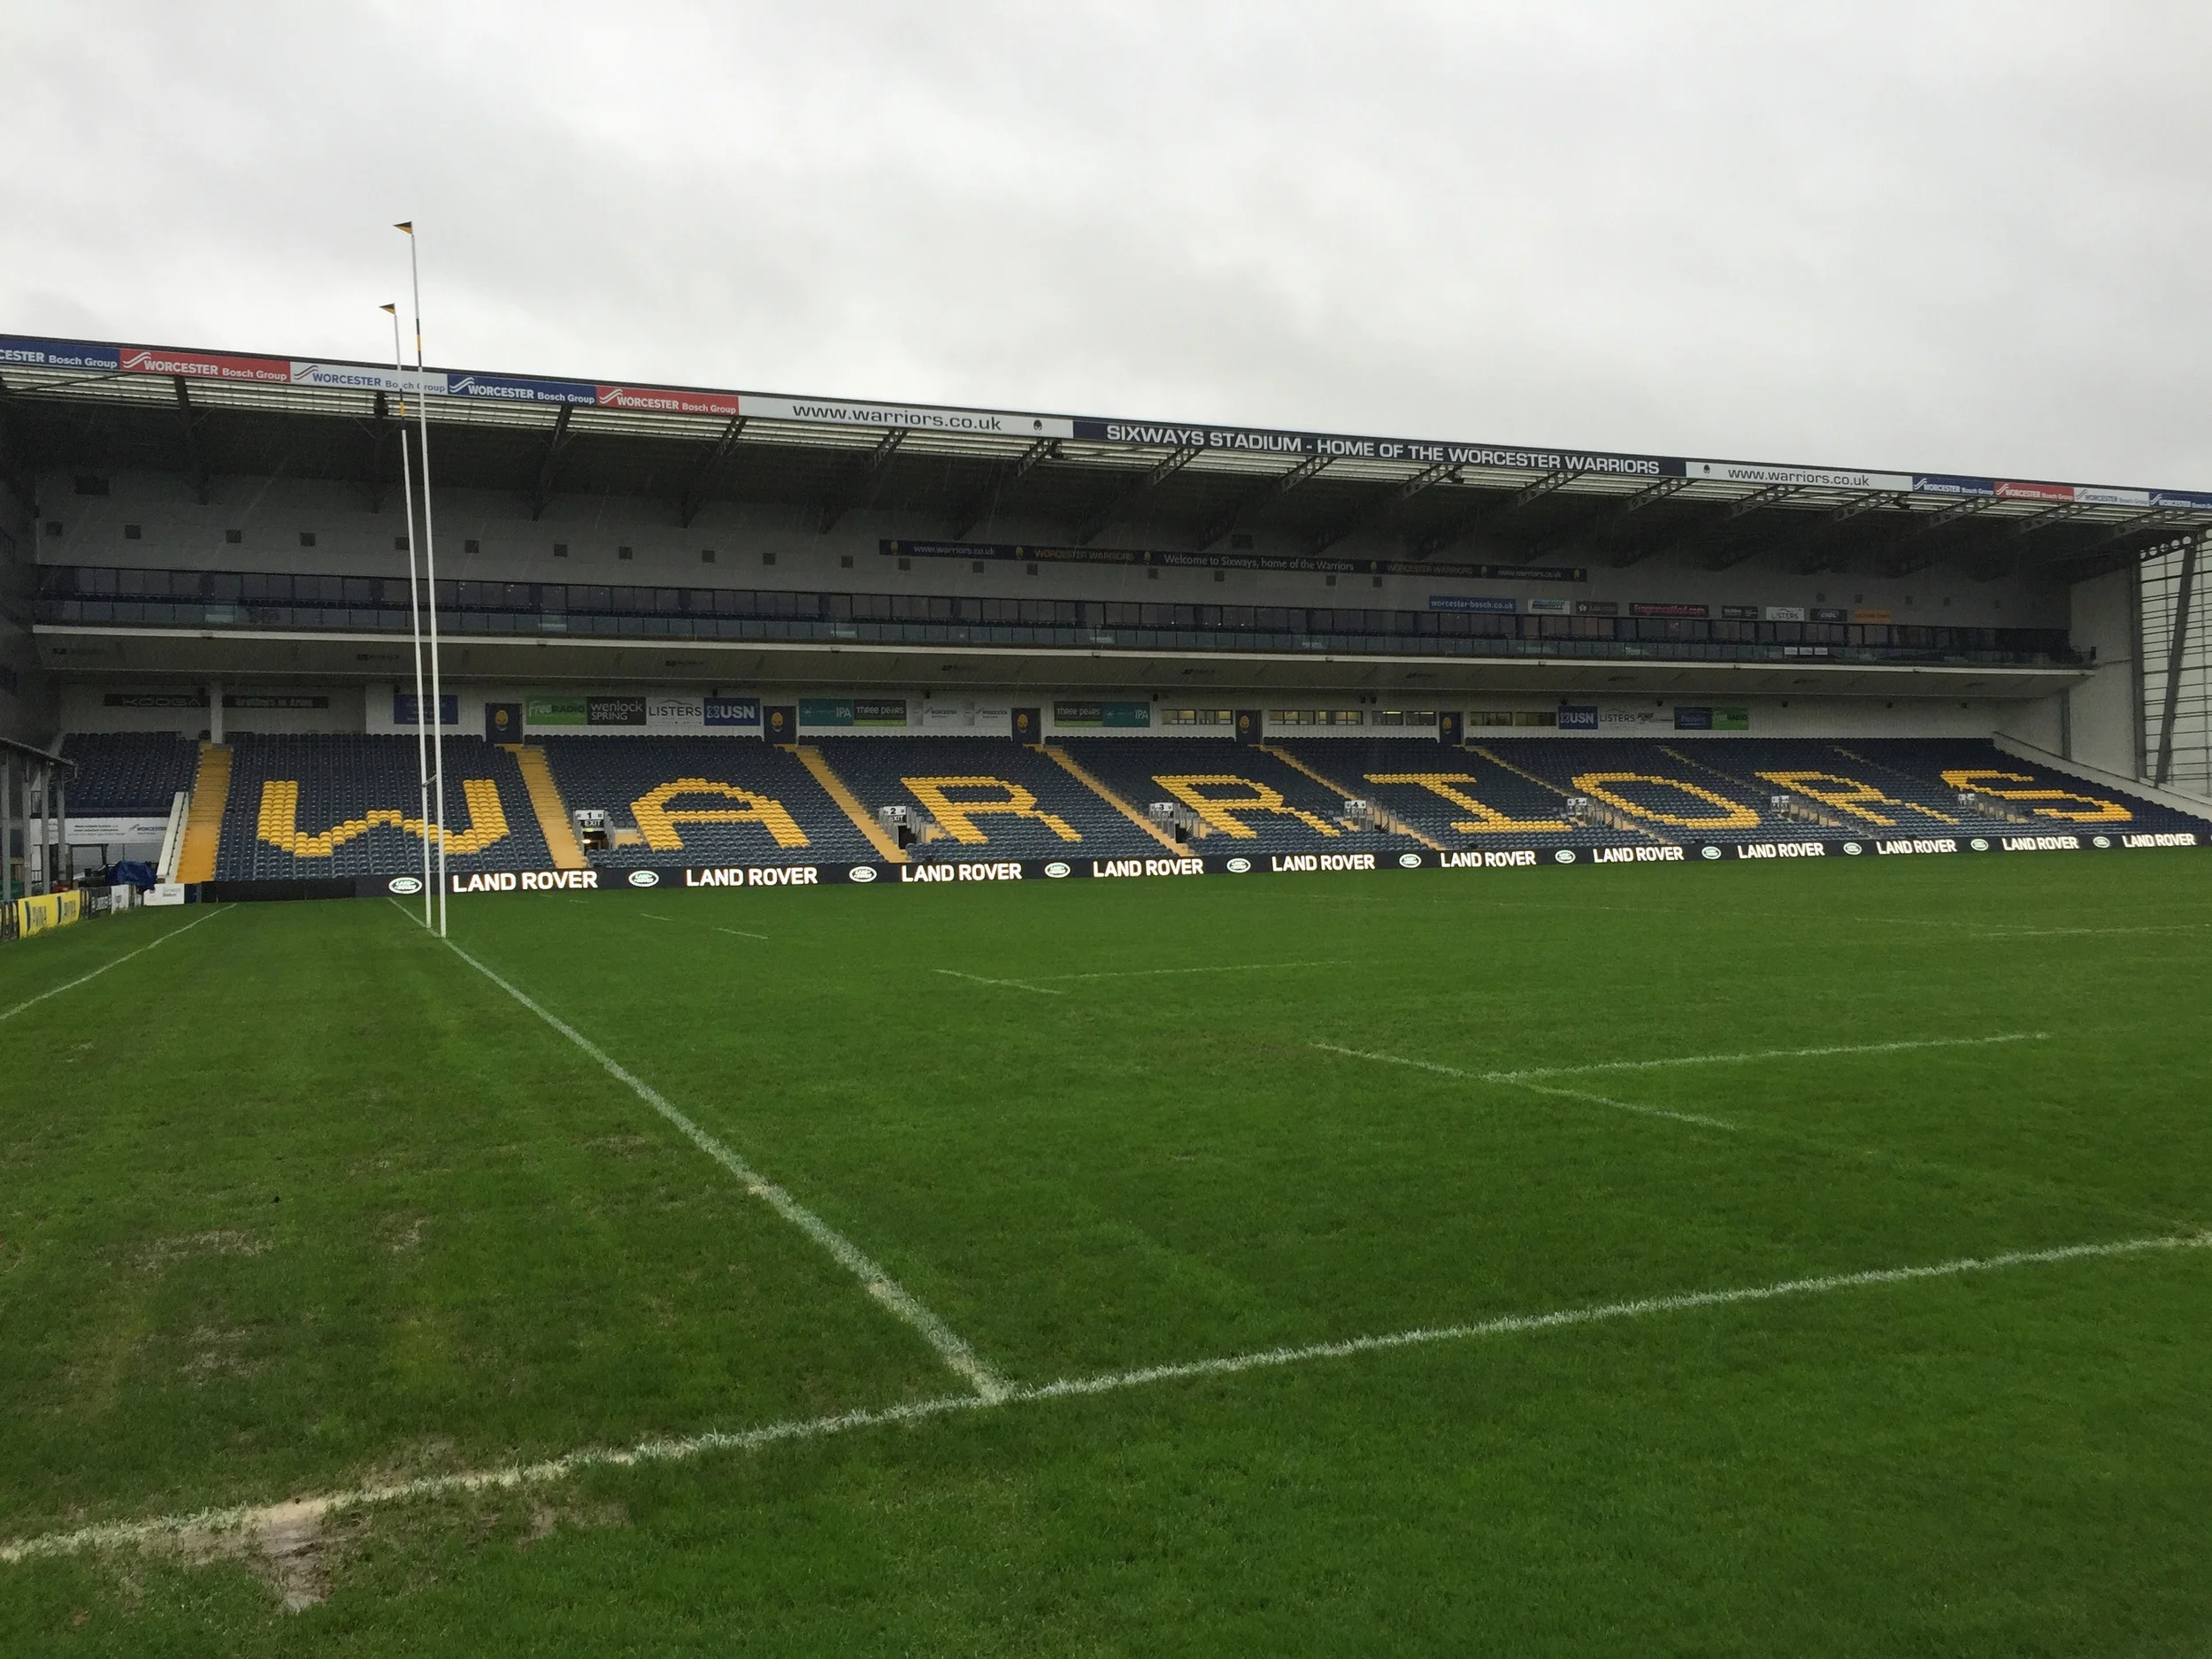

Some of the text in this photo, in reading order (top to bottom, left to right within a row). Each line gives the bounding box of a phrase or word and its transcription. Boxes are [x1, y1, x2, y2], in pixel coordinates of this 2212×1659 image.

[49, 355, 82, 366] Bosch
[84, 358, 118, 370] Group
[144, 360, 288, 381] WORCESTER Bosch Group
[312, 373, 381, 387] WORCESTER
[385, 380, 413, 390] Boch
[468, 384, 595, 405] WORCESTER Bosch Group
[618, 396, 736, 415] WORCESTER Bosch Group
[792, 404, 1002, 432] www.warriors.co.uk
[1106, 425, 1205, 446] SIXWAYS
[1210, 432, 1302, 453] STADIUM
[1317, 439, 1375, 457] HOME
[1379, 443, 1404, 458] OF
[1407, 445, 1444, 462] THE
[1448, 448, 1562, 469] WORCESTER
[1564, 456, 1660, 475] WARRIORS
[1728, 466, 1870, 488] www.warriors.co.uk
[1924, 483, 1961, 493] WORCESTER
[2006, 489, 2041, 498] WORCESTER
[913, 545, 995, 556] www.warriors.co.uk
[1034, 549, 1134, 562] WORCESTER WARRIORS
[1164, 554, 1354, 571] Welcome to Sixways, home of the Warriors
[590, 700, 643, 712] wenlock
[649, 705, 703, 717] LISTERS
[718, 704, 756, 719] USN
[835, 707, 852, 718] IPA
[1134, 710, 1148, 719] IPA
[590, 711, 629, 721] SPRING
[1570, 711, 1594, 724] USN
[1599, 713, 1635, 723] LISTERS
[1876, 840, 1913, 856] LAND
[1914, 839, 1958, 854] ROVER
[2002, 836, 2037, 851] LAND
[2037, 835, 2079, 850] ROVER
[2123, 833, 2155, 849] LAND
[2154, 833, 2197, 847] ROVER
[1440, 850, 1537, 869] LAND ROVER
[1592, 847, 1634, 864] LAND
[1636, 846, 1685, 862] ROVER
[1737, 844, 1776, 860] LAND
[1778, 842, 1825, 858] ROVER
[1093, 857, 1204, 879] LAND ROVER
[1271, 854, 1376, 872] LAND ROVER
[686, 866, 818, 887] LAND ROVER
[901, 862, 1023, 883] LAND ROVER
[452, 870, 598, 893] LAND ROVER
